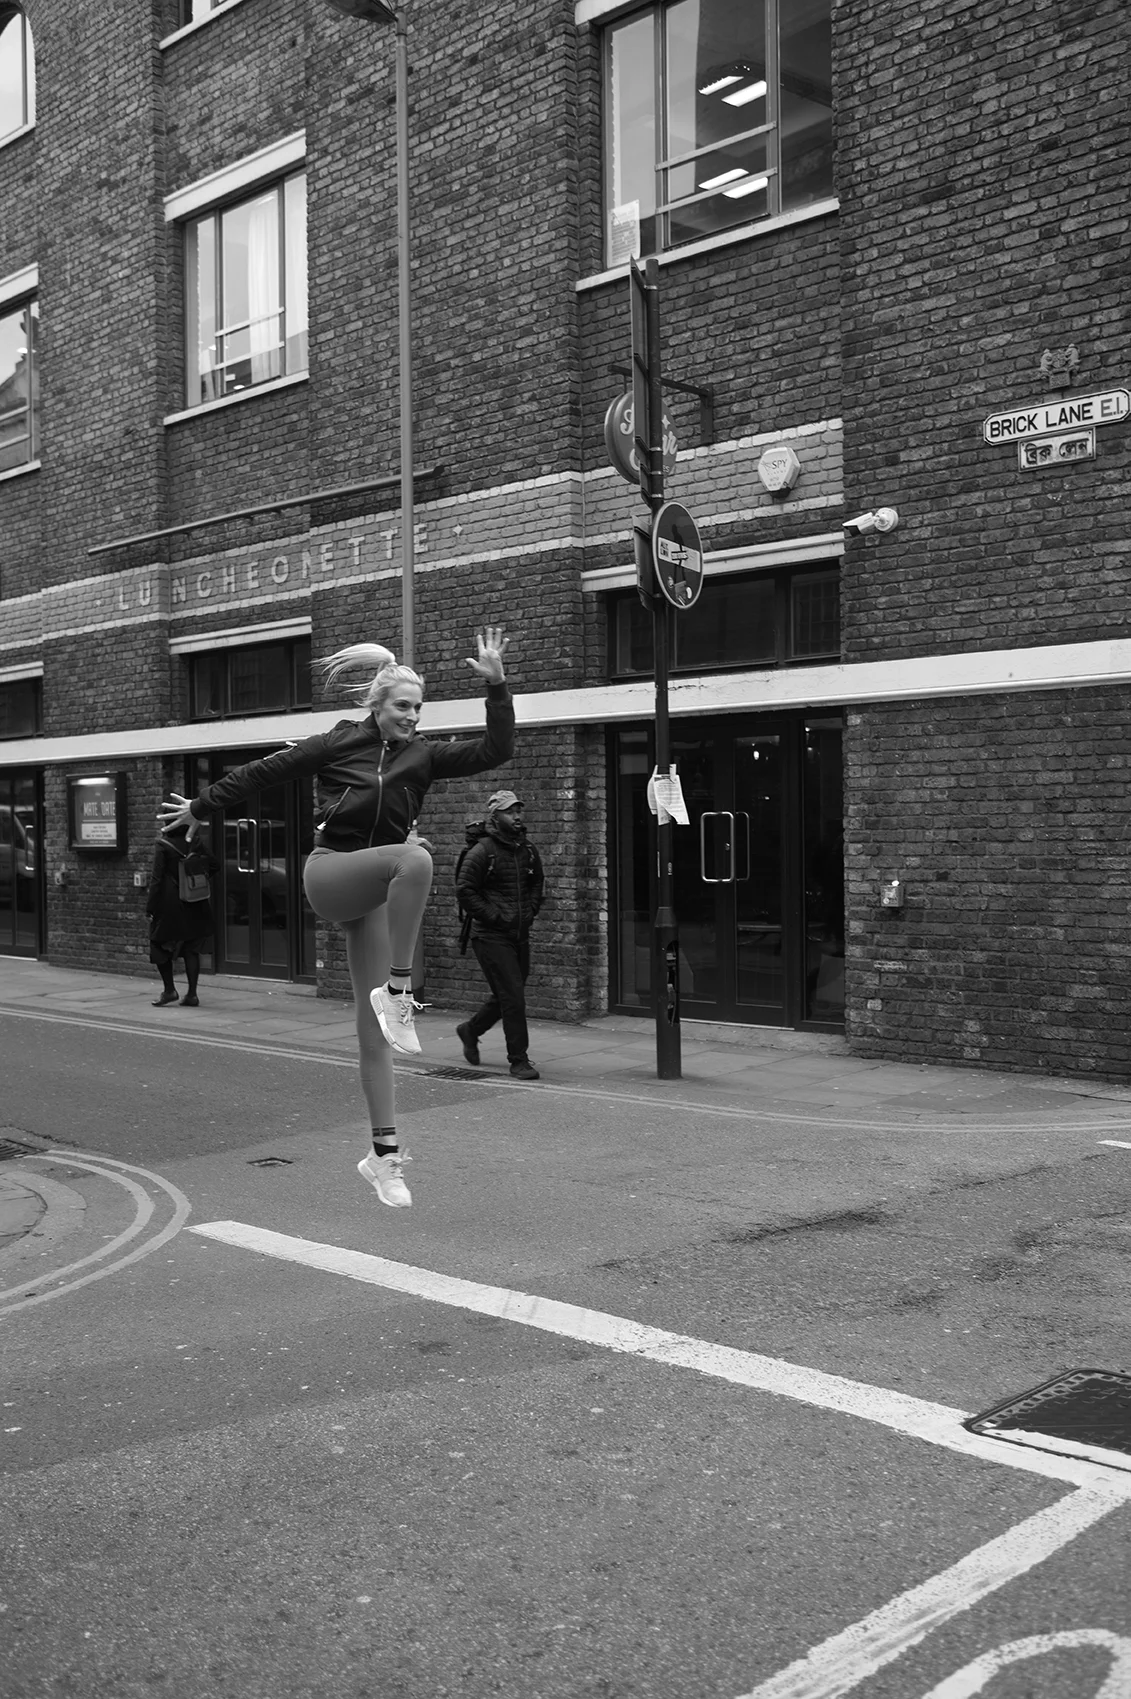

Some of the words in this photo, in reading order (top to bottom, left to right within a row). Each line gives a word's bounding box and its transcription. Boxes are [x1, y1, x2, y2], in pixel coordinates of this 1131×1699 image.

[990, 413, 1038, 438] BRICK
[1045, 402, 1093, 427] LANE
[772, 459, 788, 470] SPY
[118, 523, 429, 610] LUNCHEONETTE
